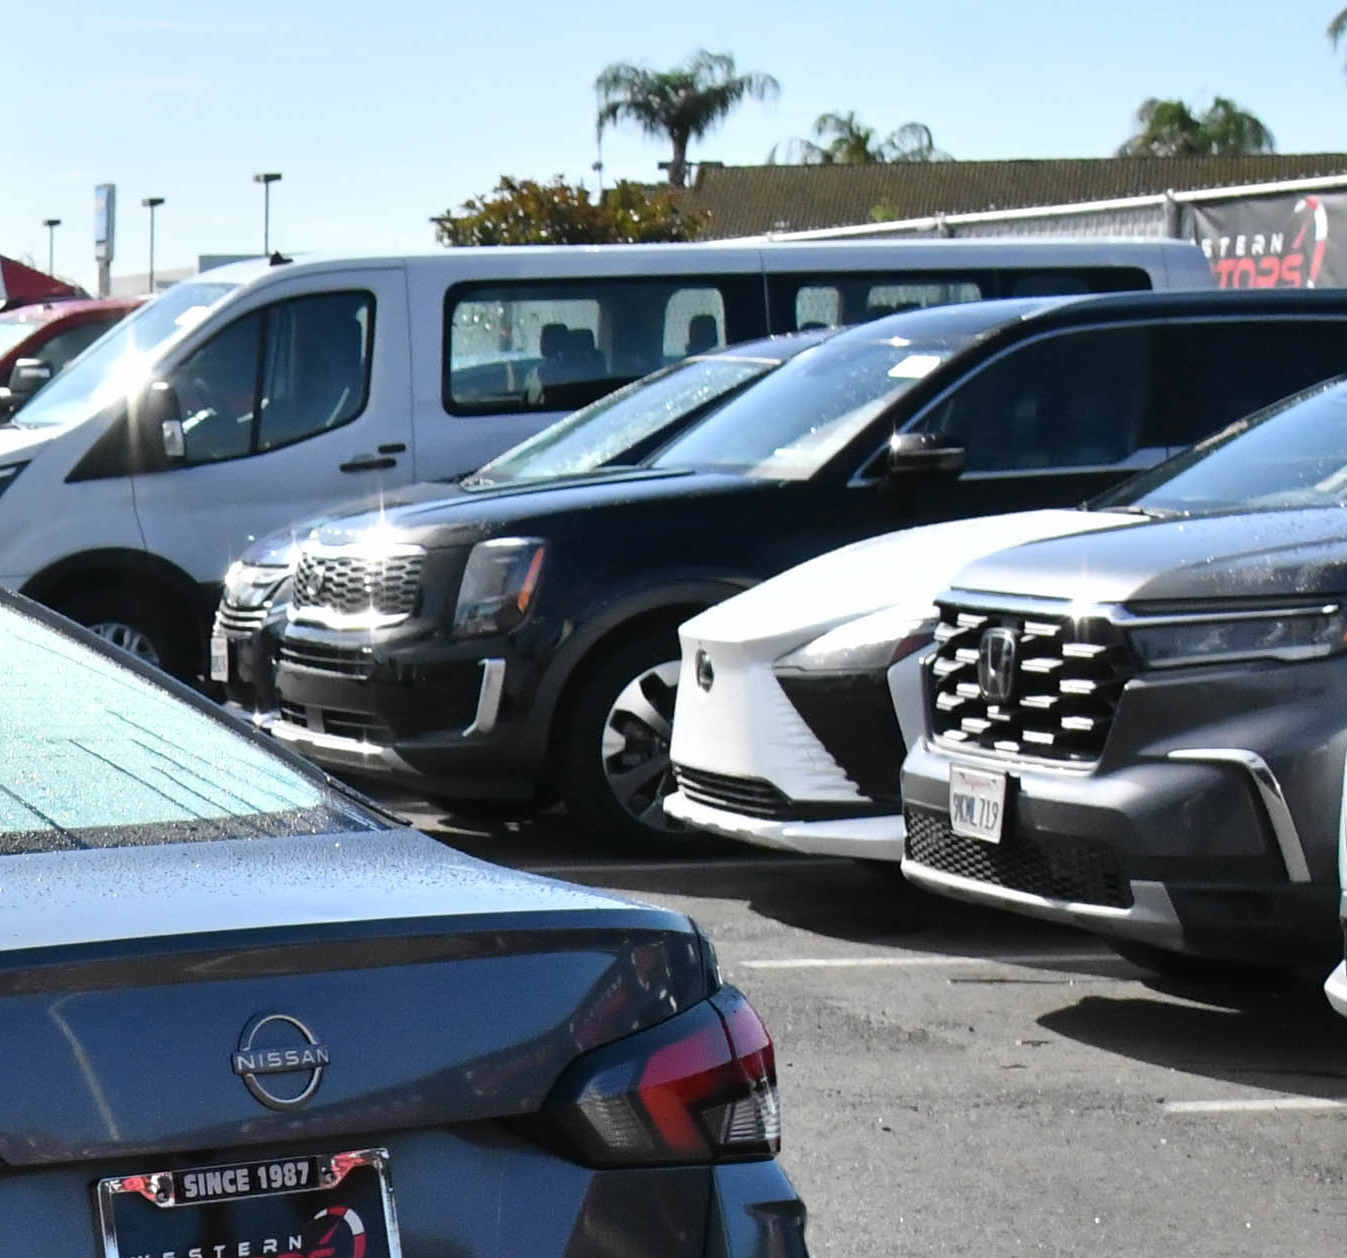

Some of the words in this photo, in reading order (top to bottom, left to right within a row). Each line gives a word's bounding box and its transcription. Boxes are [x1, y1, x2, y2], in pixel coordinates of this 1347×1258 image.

[1190, 232, 1284, 259] STERN
[1210, 254, 1304, 289] TORS
[237, 1049, 330, 1071] NISSAN
[183, 1171, 250, 1198] SINCE
[257, 1162, 310, 1189] 1987
